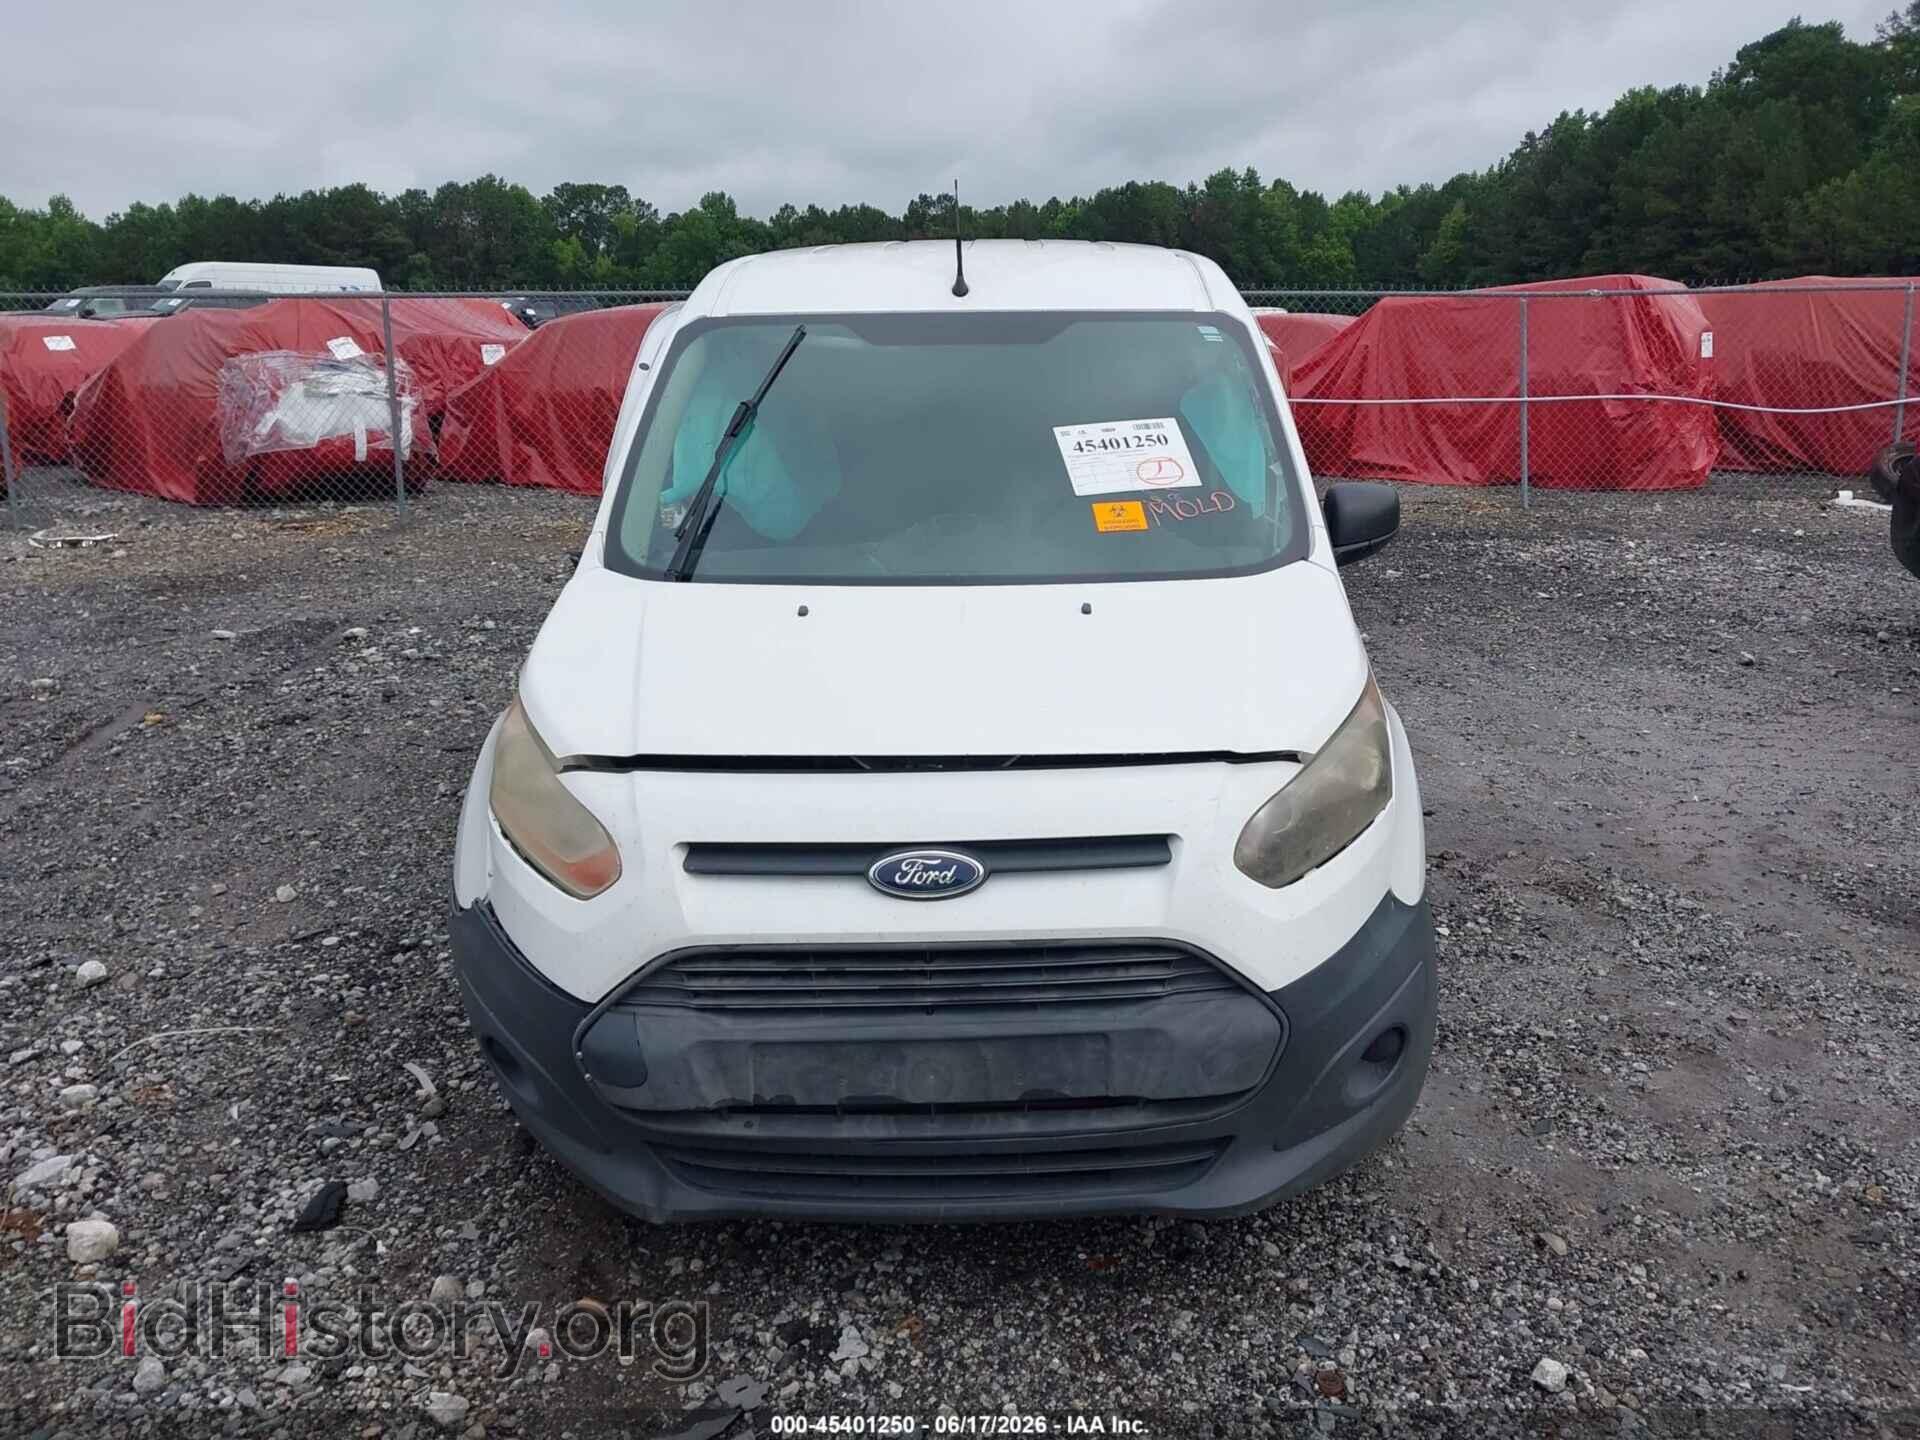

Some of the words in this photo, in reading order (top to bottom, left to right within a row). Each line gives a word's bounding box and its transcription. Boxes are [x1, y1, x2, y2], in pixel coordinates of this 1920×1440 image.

[1073, 433, 1169, 453] 45401250
[1149, 491, 1235, 526] MOLD
[894, 858, 958, 886] Ford
